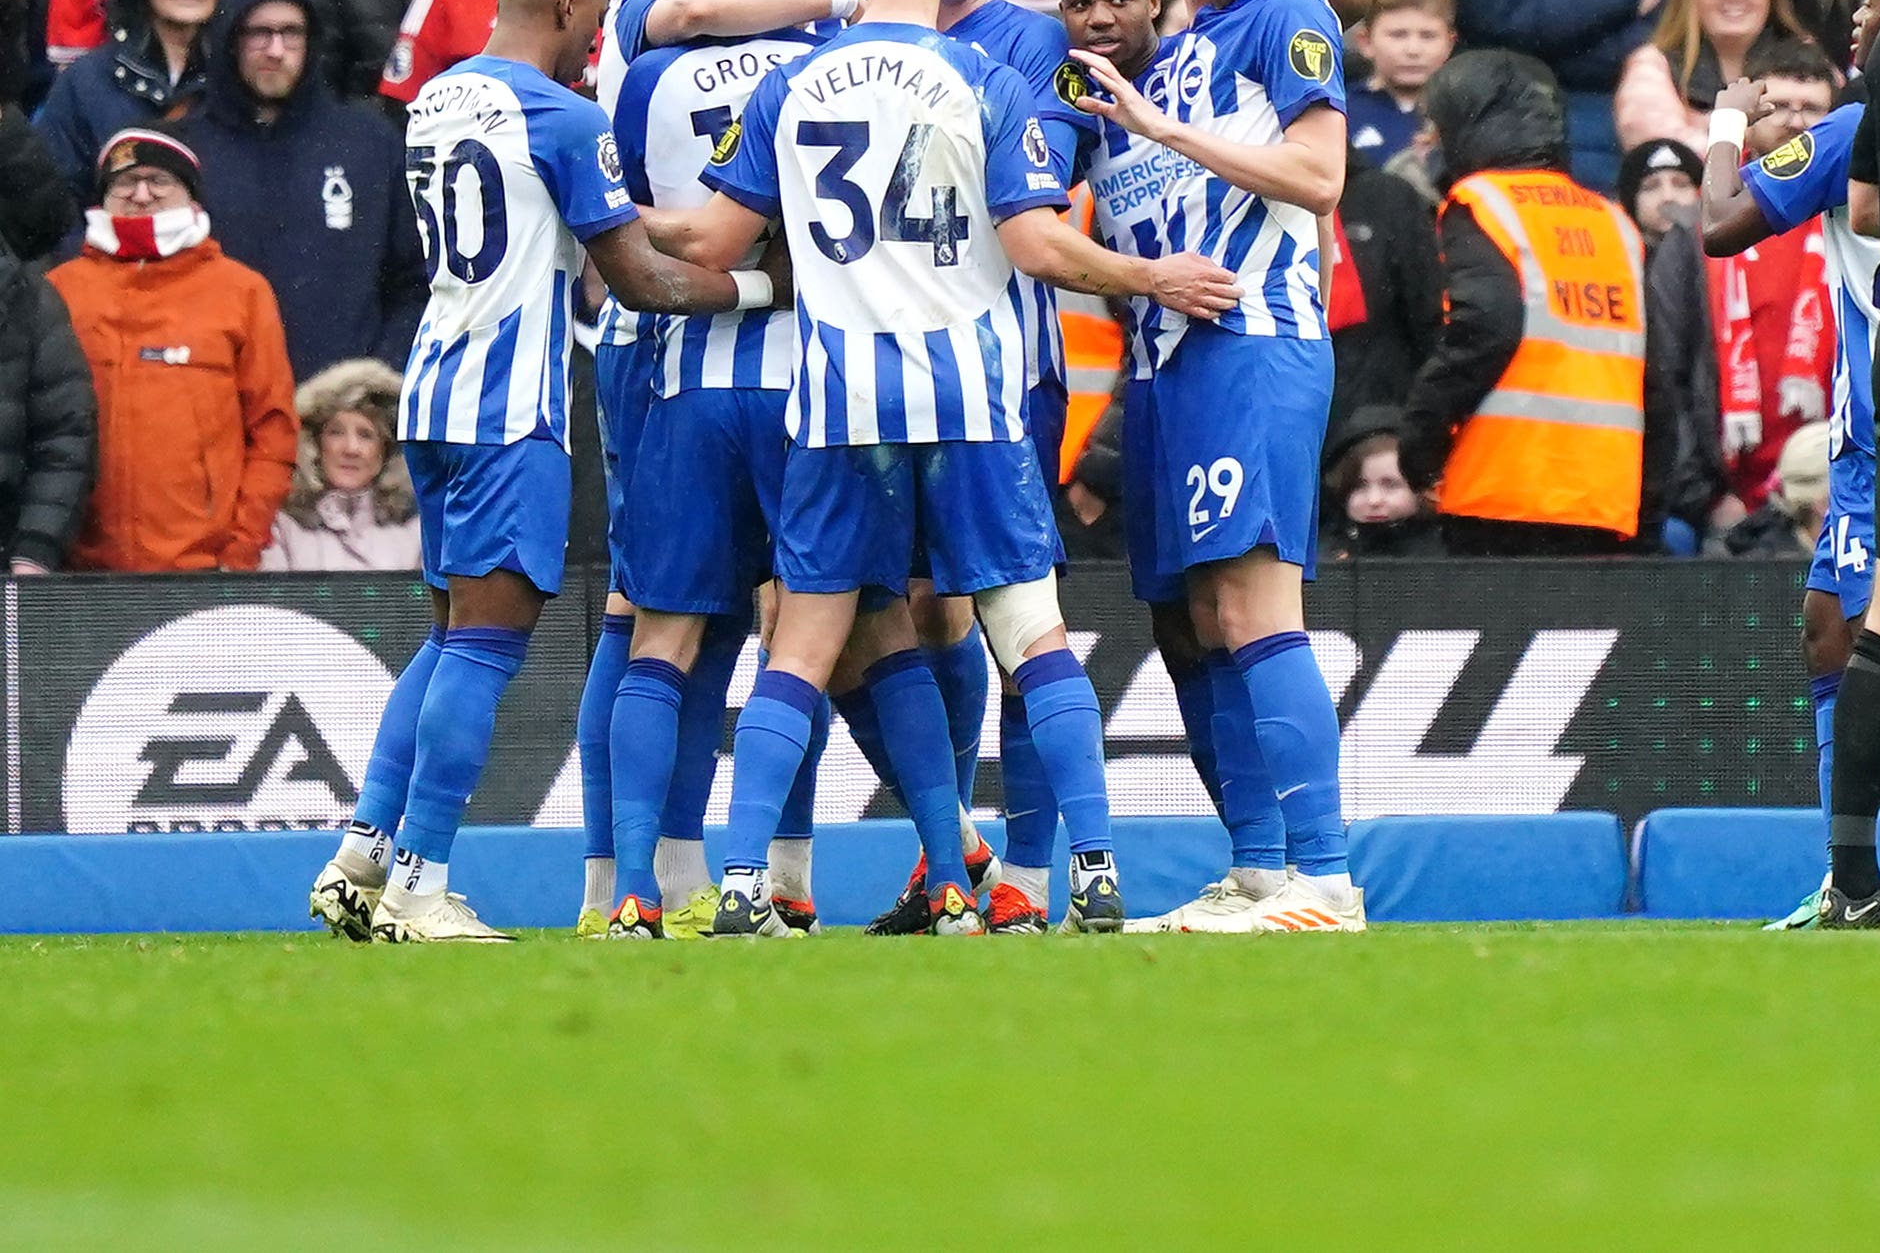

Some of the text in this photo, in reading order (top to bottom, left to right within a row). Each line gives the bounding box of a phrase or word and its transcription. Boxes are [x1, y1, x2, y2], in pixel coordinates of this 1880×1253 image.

[804, 55, 950, 109] VELTMAN
[795, 120, 970, 268] 34
[1186, 456, 1244, 526] 29
[131, 691, 359, 808] EA
